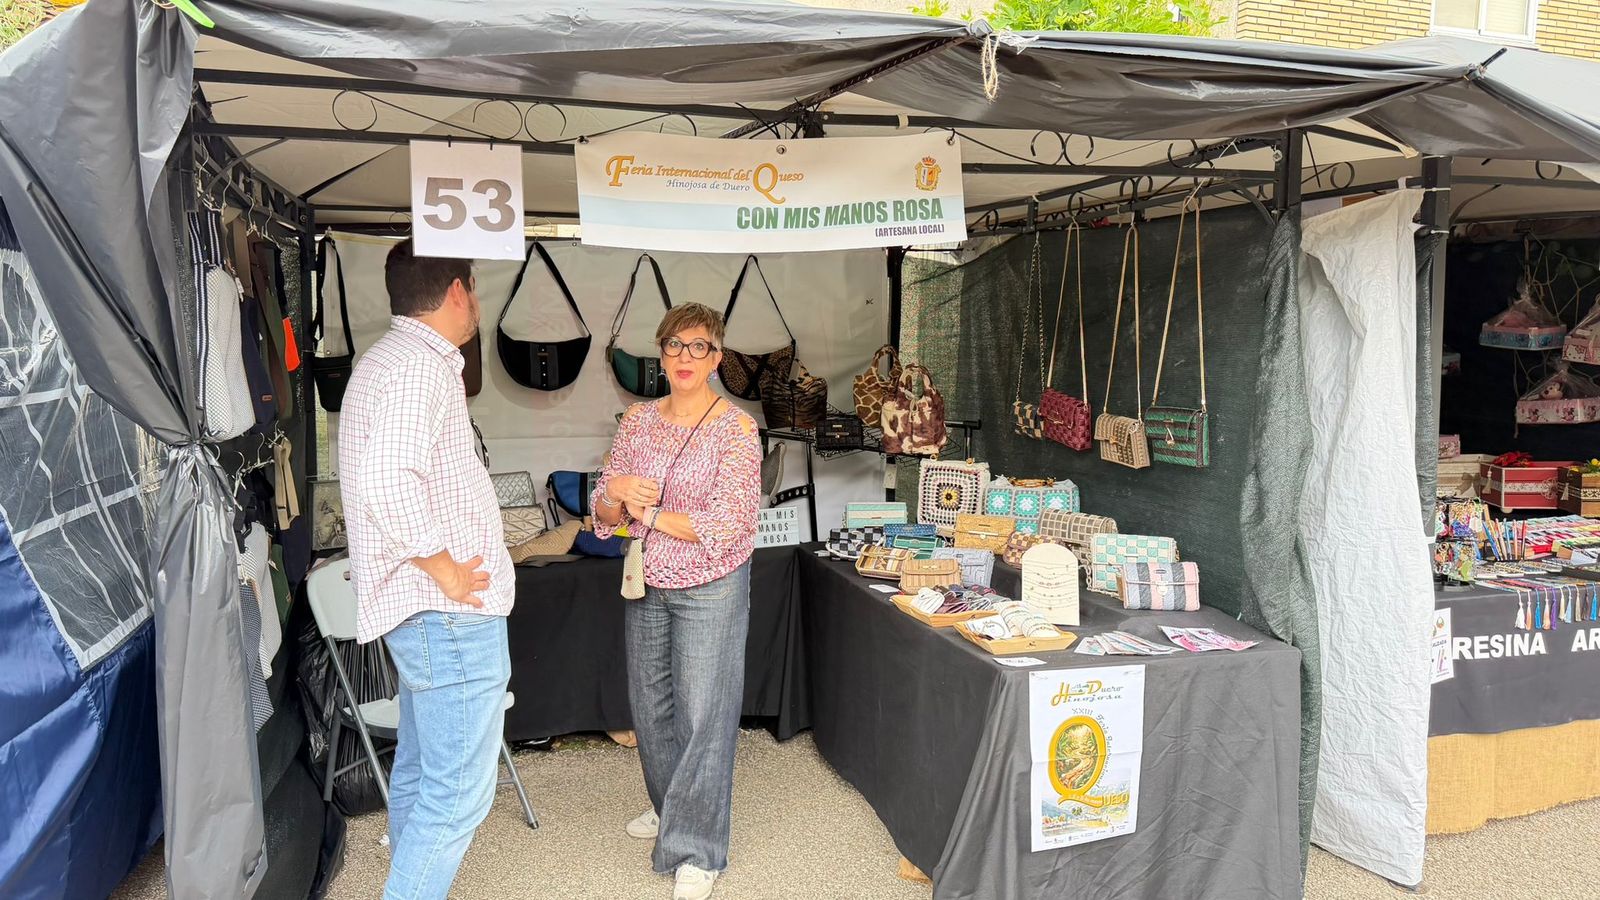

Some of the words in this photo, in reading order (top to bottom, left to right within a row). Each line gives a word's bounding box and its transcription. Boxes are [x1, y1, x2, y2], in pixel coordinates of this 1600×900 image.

[605, 155, 654, 187] Feria
[656, 165, 733, 181] Internacional
[733, 168, 752, 181] del
[752, 162, 805, 204] Queso
[666, 179, 708, 192] Hinojosa
[709, 181, 720, 190] de
[723, 182, 751, 192] Duero
[422, 177, 516, 232] 53
[736, 206, 779, 229] CON
[783, 206, 821, 229] MIS
[823, 201, 888, 226] MANOS
[893, 198, 944, 222] ROSA
[875, 225, 918, 237] (ARTESANA
[919, 224, 945, 235] LOCAL)
[757, 512, 768, 521] ON
[776, 510, 795, 519] MIS
[758, 523, 789, 533] MANOS
[763, 534, 788, 544] ROSA
[1453, 632, 1547, 660] RESINA
